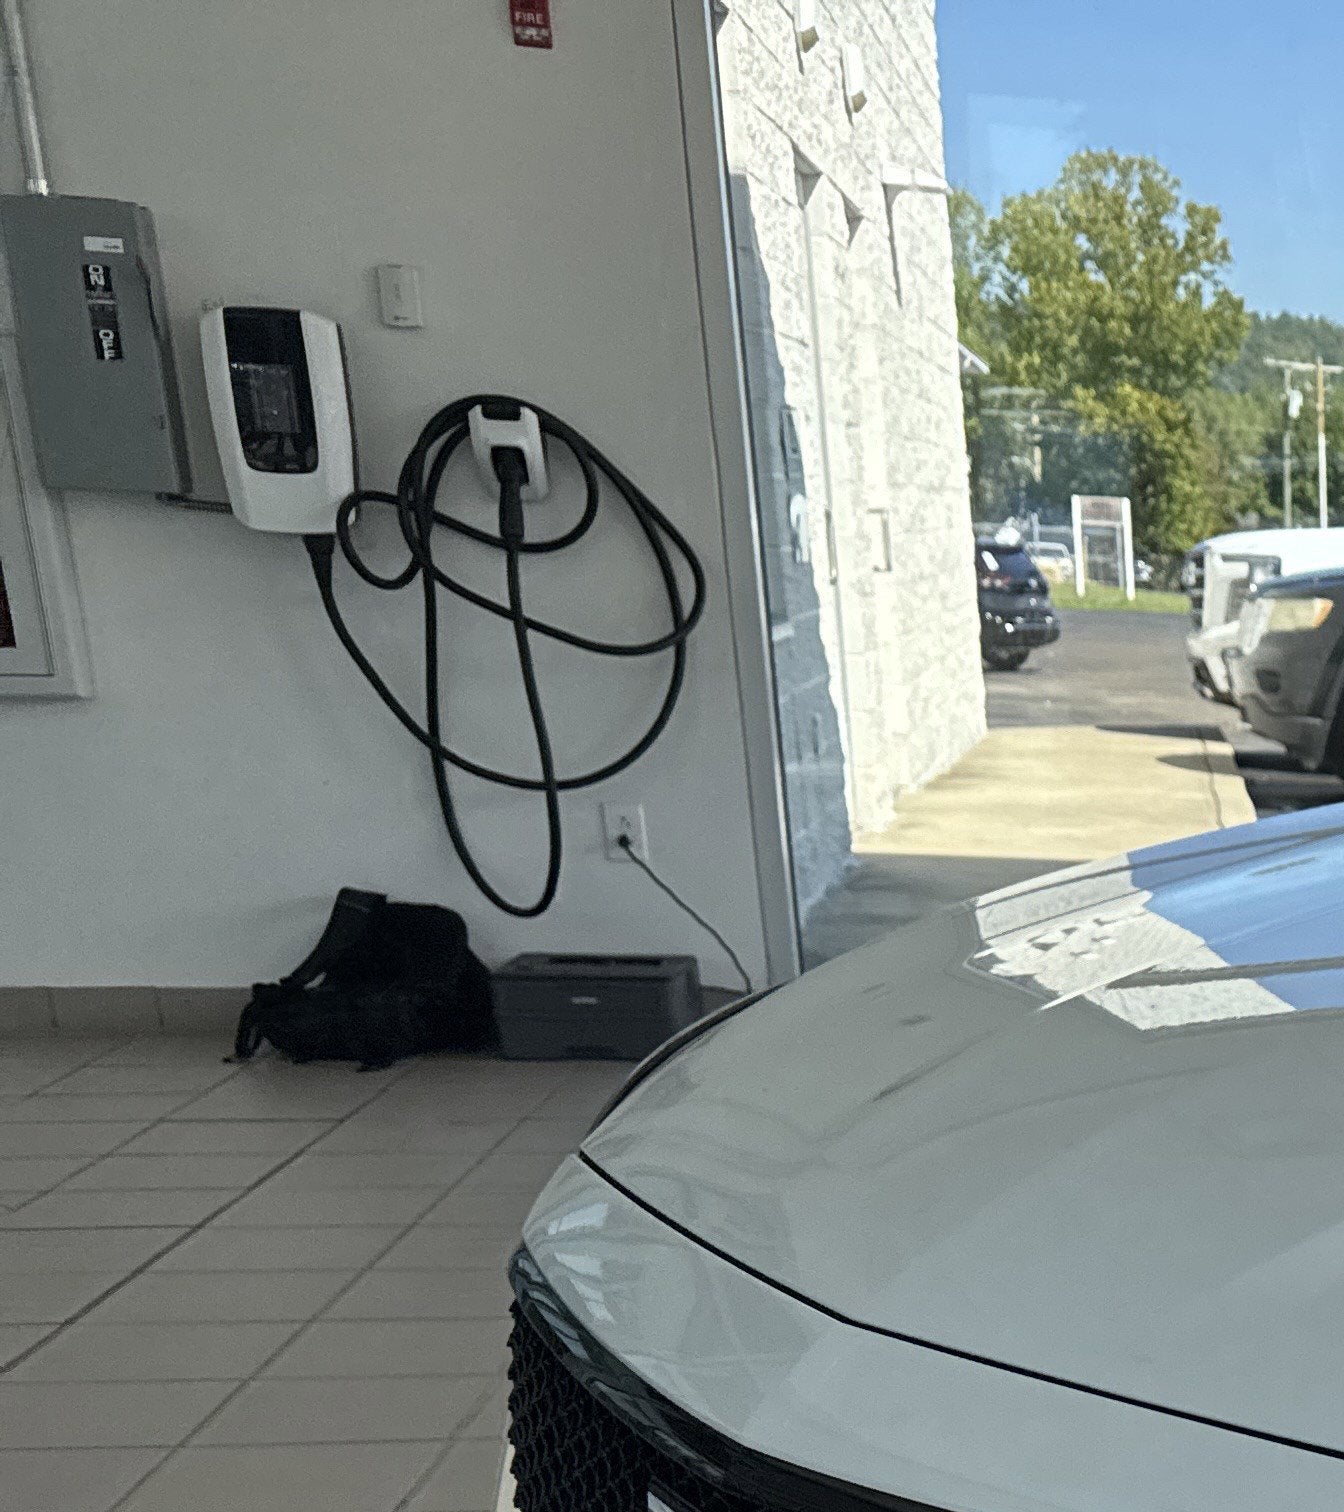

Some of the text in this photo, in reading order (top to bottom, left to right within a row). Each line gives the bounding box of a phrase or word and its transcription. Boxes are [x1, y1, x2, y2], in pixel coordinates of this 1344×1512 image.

[514, 10, 545, 25] FIRE
[88, 264, 106, 287] ON
[99, 328, 116, 361] OFF
